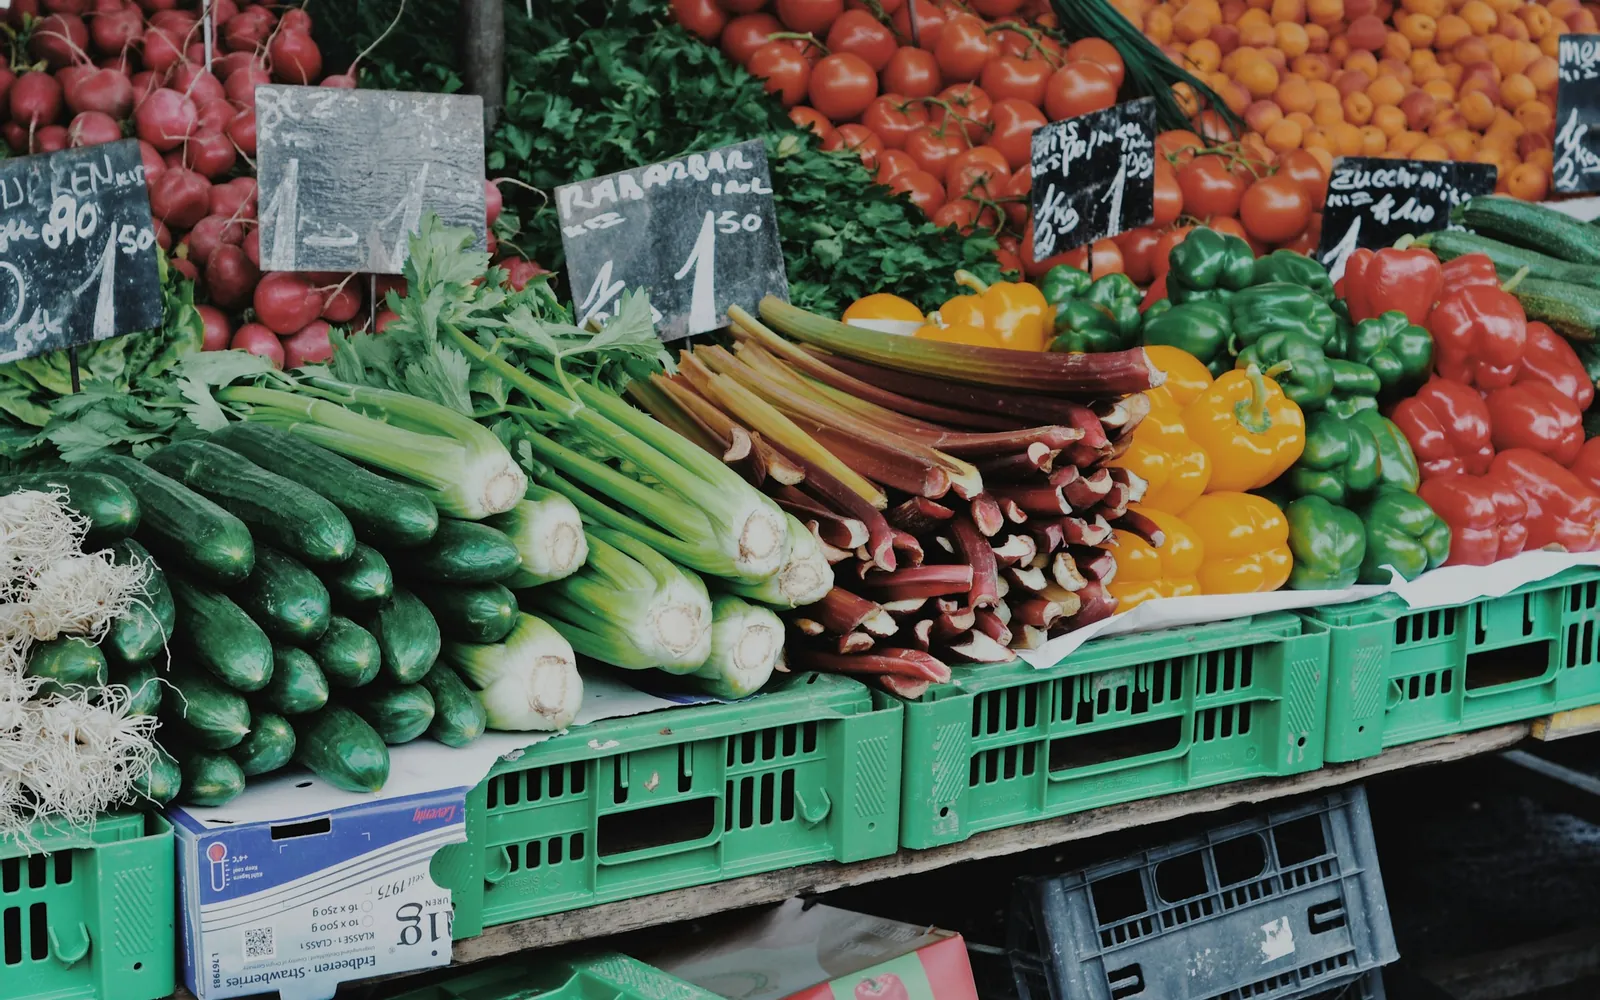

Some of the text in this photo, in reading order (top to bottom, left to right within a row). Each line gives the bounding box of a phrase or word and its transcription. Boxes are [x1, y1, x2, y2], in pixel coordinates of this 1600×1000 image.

[377, 872, 426, 901] seit 1975
[320, 905, 338, 917] 250
[348, 904, 358, 914] 16
[319, 920, 339, 932] 500
[348, 918, 359, 929] 10
[305, 938, 332, 951] CLASS
[343, 931, 375, 945] KLASSE
[211, 958, 220, 989] 767983
[225, 955, 376, 989] Erdbeeren Strawberries
